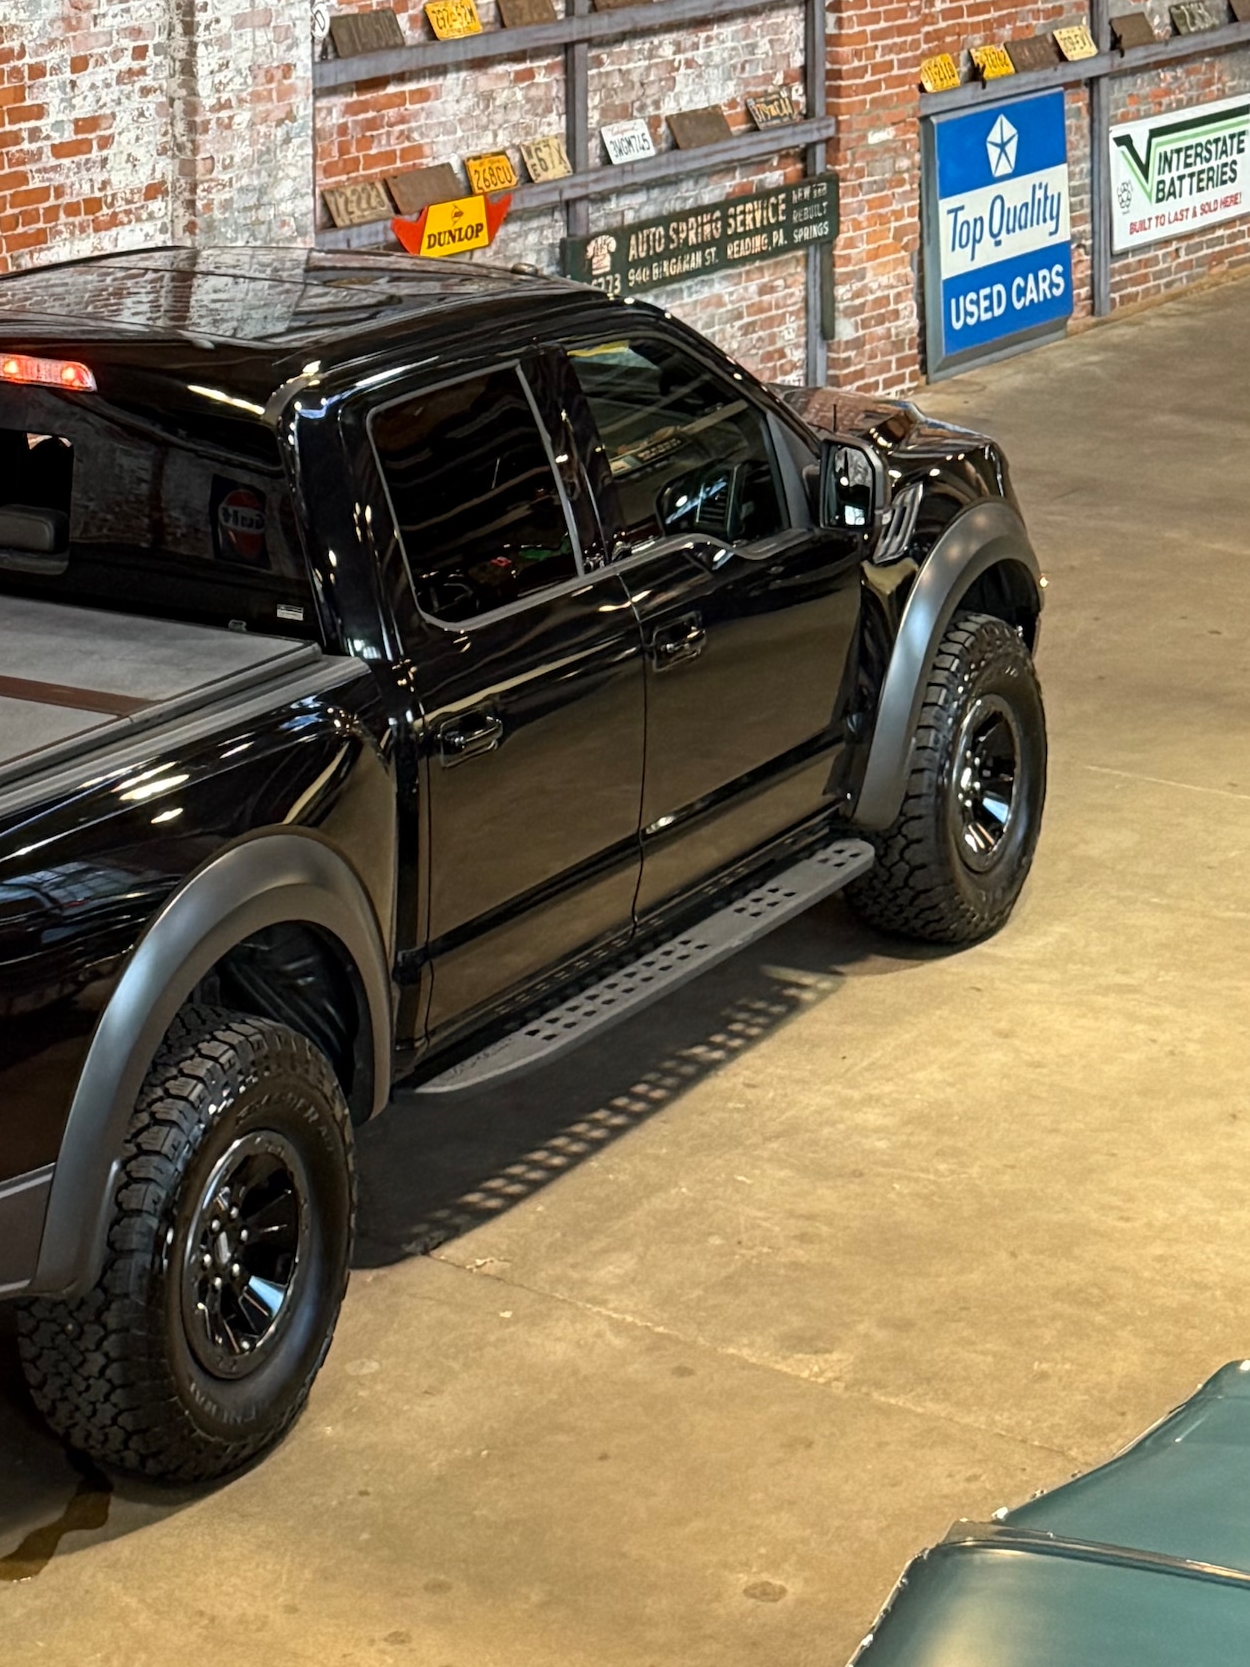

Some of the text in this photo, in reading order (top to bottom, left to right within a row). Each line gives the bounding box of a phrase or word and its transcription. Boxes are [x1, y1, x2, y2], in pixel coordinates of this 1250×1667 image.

[1157, 129, 1247, 176] INTERSTATE
[473, 165, 512, 192] 268CU
[792, 185, 811, 204] NEW
[1155, 159, 1238, 204] BATTERIES
[628, 192, 787, 263] AUTO SPRING SERVICE
[792, 201, 829, 224] REBUILT
[946, 182, 1062, 262] Top Quality
[1129, 217, 1152, 235] BUILT
[1155, 214, 1166, 227] TO
[1168, 208, 1190, 224] LAST
[1200, 199, 1219, 216] SOLD
[1220, 192, 1242, 209] HERE!
[426, 222, 484, 250] DUNLOP
[792, 220, 830, 245] SPRINGS
[704, 246, 719, 267] ST.
[950, 263, 1065, 331] USED CARS
